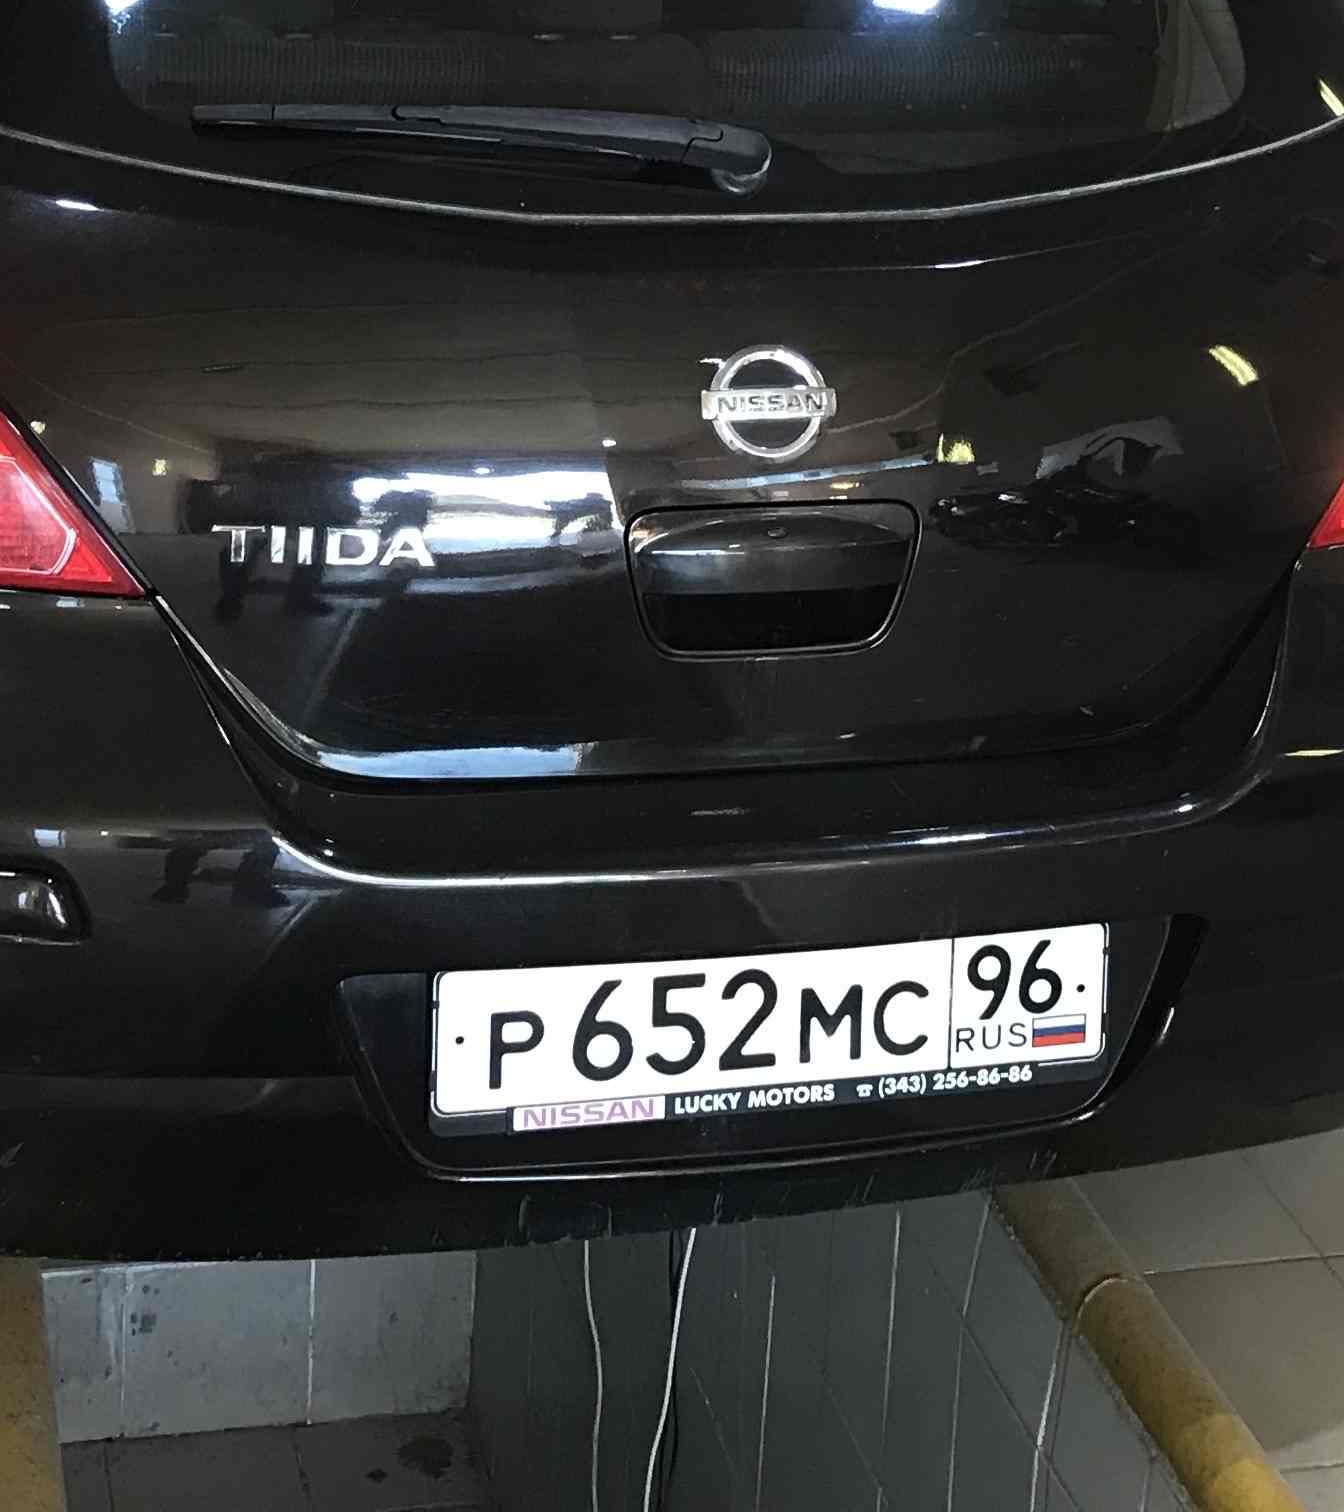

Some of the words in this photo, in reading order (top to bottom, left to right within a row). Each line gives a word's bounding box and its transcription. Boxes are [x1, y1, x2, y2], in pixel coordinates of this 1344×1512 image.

[717, 392, 824, 414] NISSAN
[211, 523, 436, 568] TIIDA
[967, 938, 1063, 1020] 96
[955, 1023, 1028, 1053] RUS
[522, 1098, 655, 1129] NISSAN
[674, 1091, 742, 1115] LUCKY
[747, 1083, 836, 1109] MOTORS
[878, 1074, 927, 1099] (343)
[932, 1064, 1033, 1091] 256-86-86
